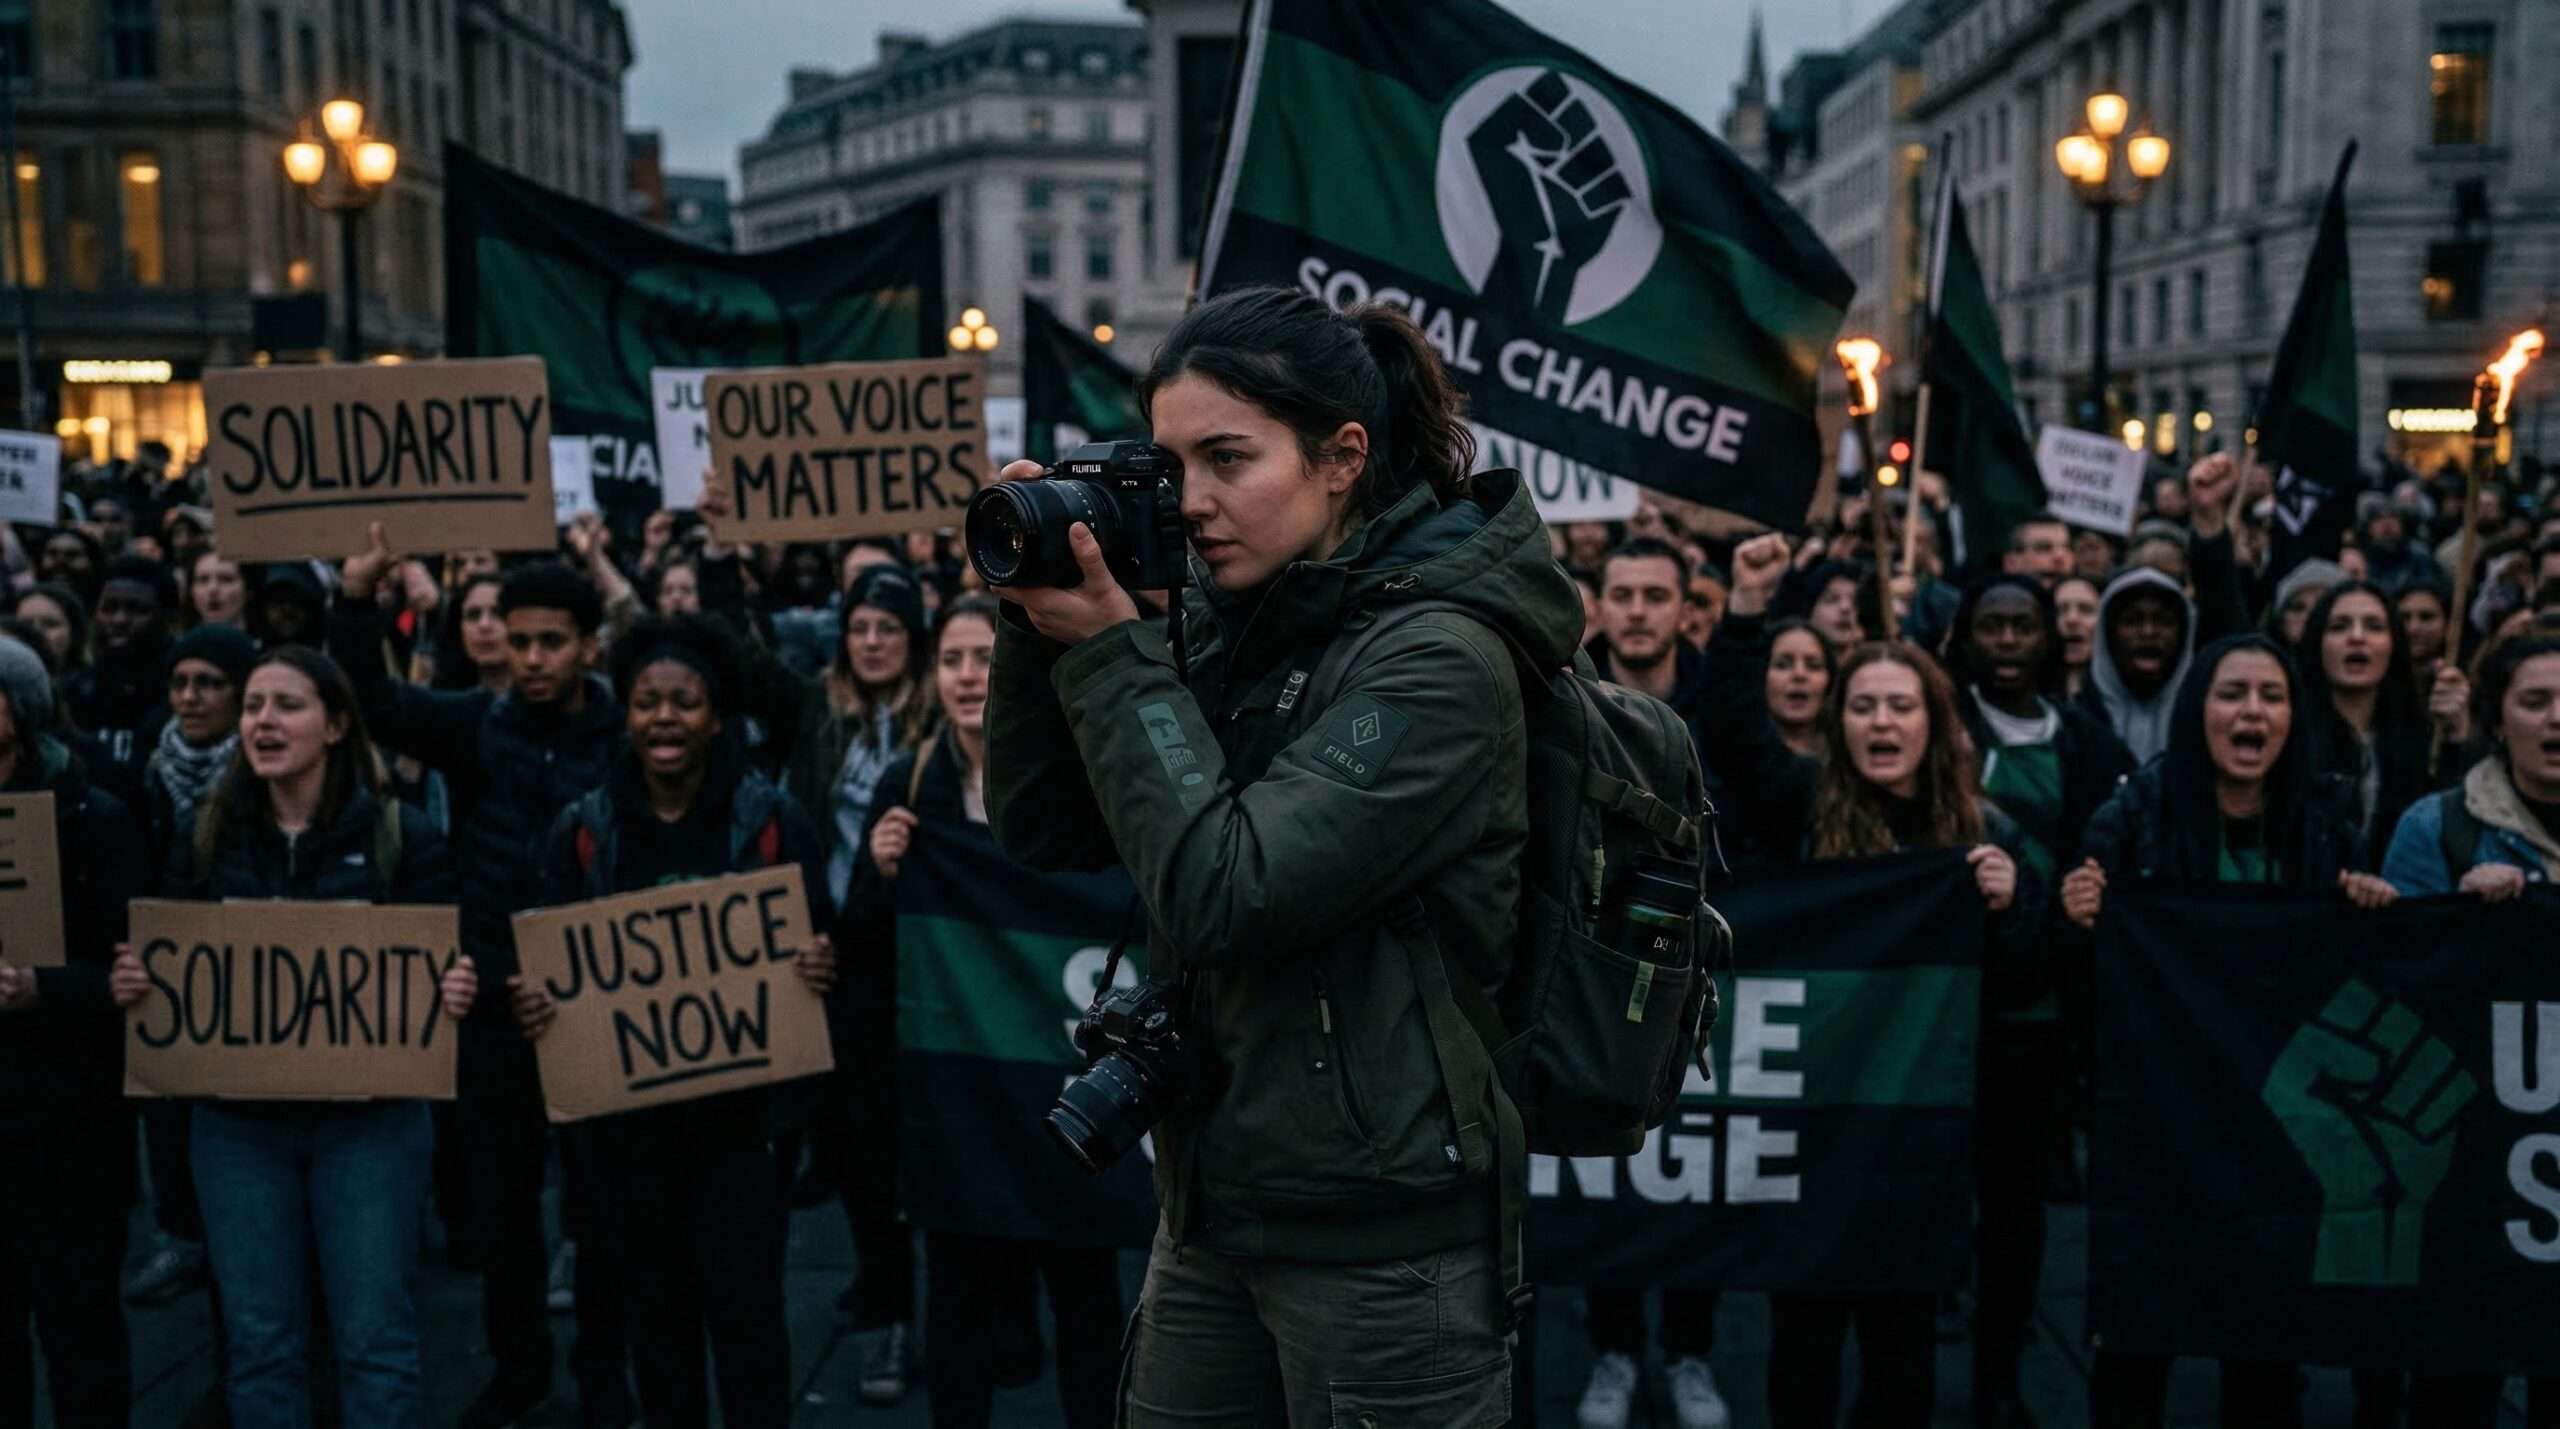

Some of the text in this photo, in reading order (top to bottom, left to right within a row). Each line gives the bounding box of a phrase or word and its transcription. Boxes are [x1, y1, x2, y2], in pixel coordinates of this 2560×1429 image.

[718, 382, 817, 438] OUR
[829, 374, 976, 434] VOICE
[1298, 256, 1748, 464] SOIAL CHANGE
[219, 396, 544, 494] SOLIDARITY
[733, 442, 979, 520] MATTERS
[1324, 745, 1365, 775] FIELD
[546, 887, 796, 1000] JUSTICE
[136, 938, 456, 1047] SOLIDARITY
[613, 981, 768, 1076] NOW
